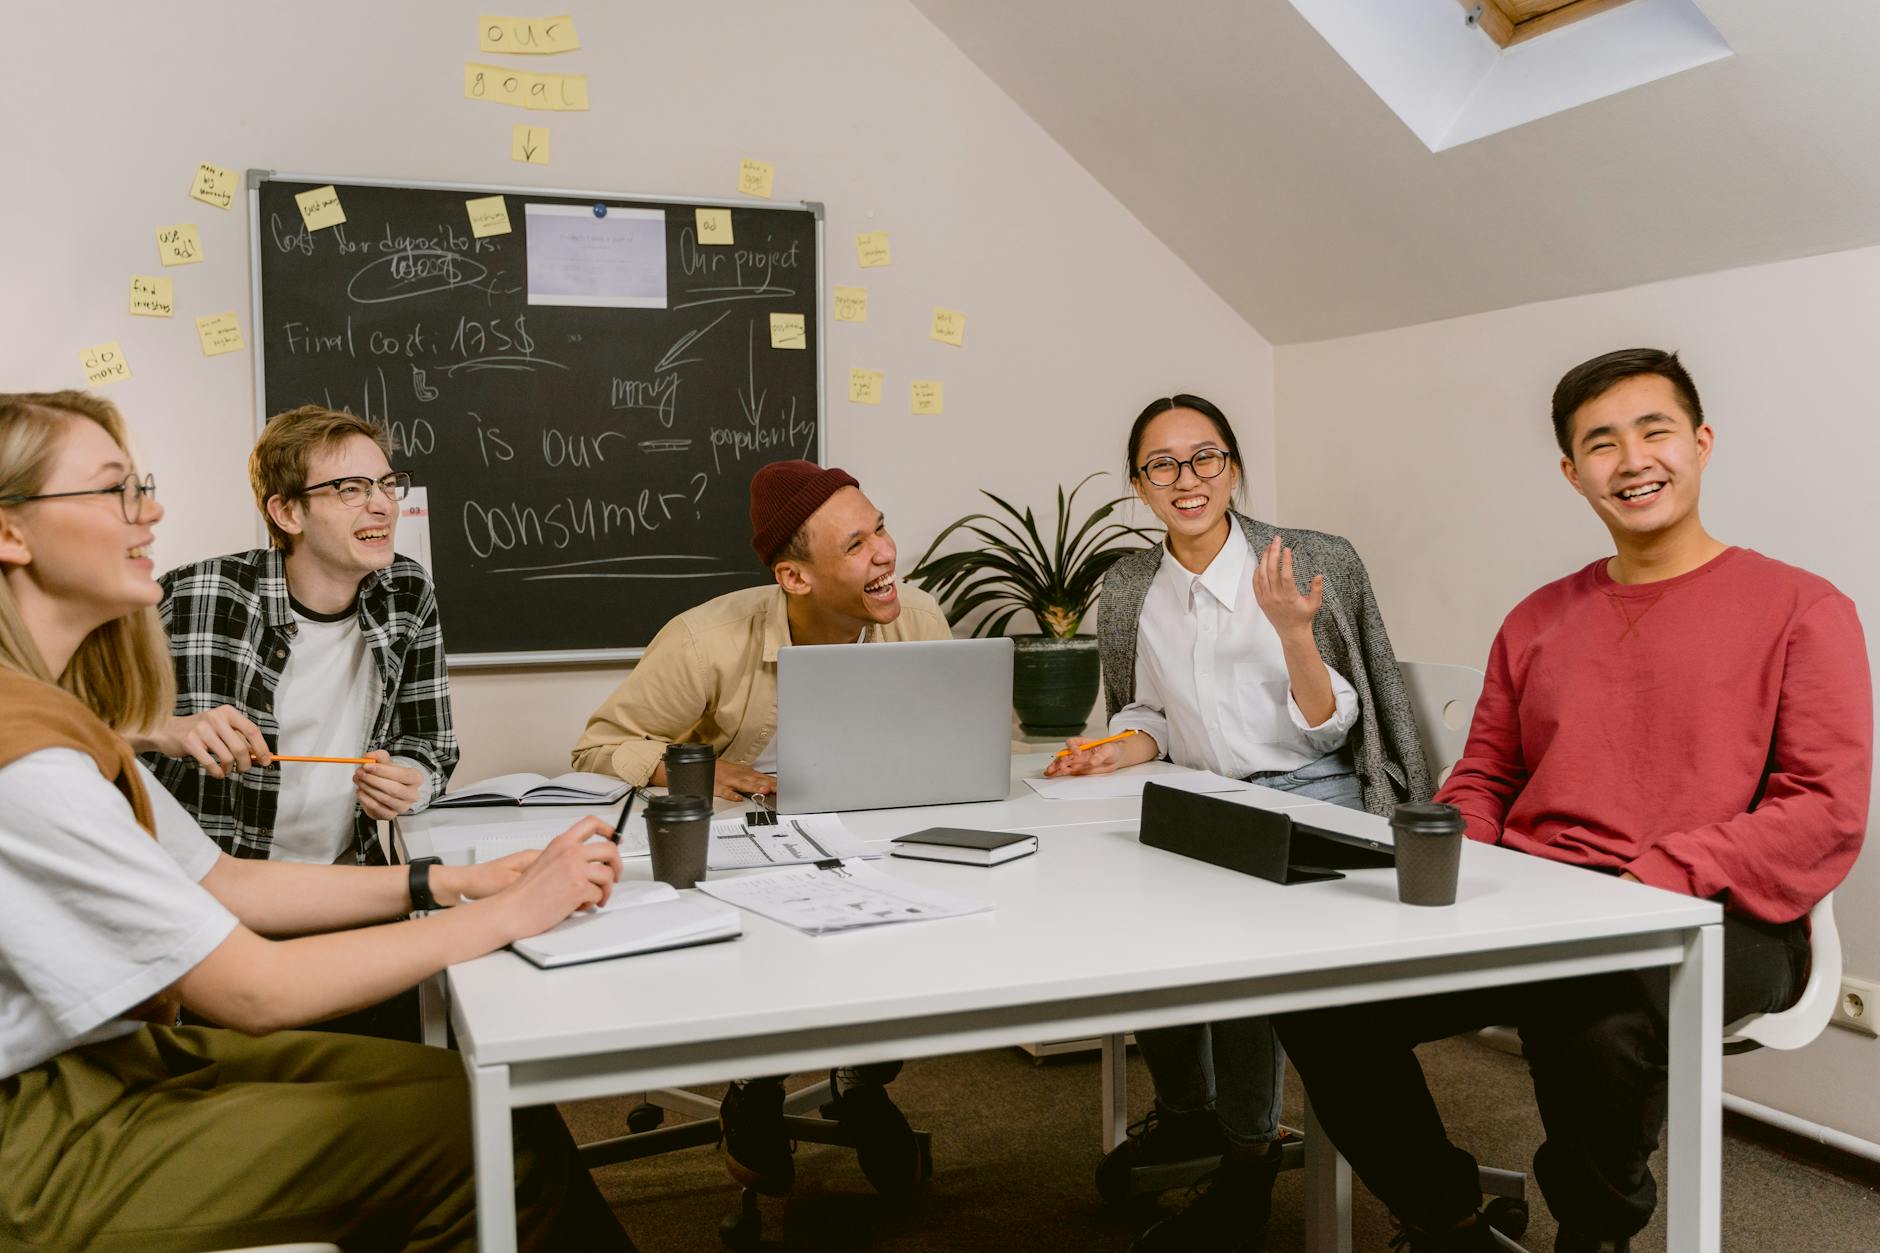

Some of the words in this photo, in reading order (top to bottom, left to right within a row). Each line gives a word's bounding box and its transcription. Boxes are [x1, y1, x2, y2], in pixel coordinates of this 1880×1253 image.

[488, 24, 560, 47] our
[472, 73, 575, 106] goal
[703, 217, 717, 231] ad
[160, 229, 180, 244] use
[680, 227, 726, 276] Our
[735, 234, 800, 294] project
[133, 279, 157, 295] find
[283, 315, 356, 358] Final
[449, 313, 535, 361] 175$
[85, 349, 114, 369] do
[89, 363, 124, 382] more
[467, 412, 514, 468] is
[543, 428, 627, 469] our
[710, 396, 815, 475] popularity
